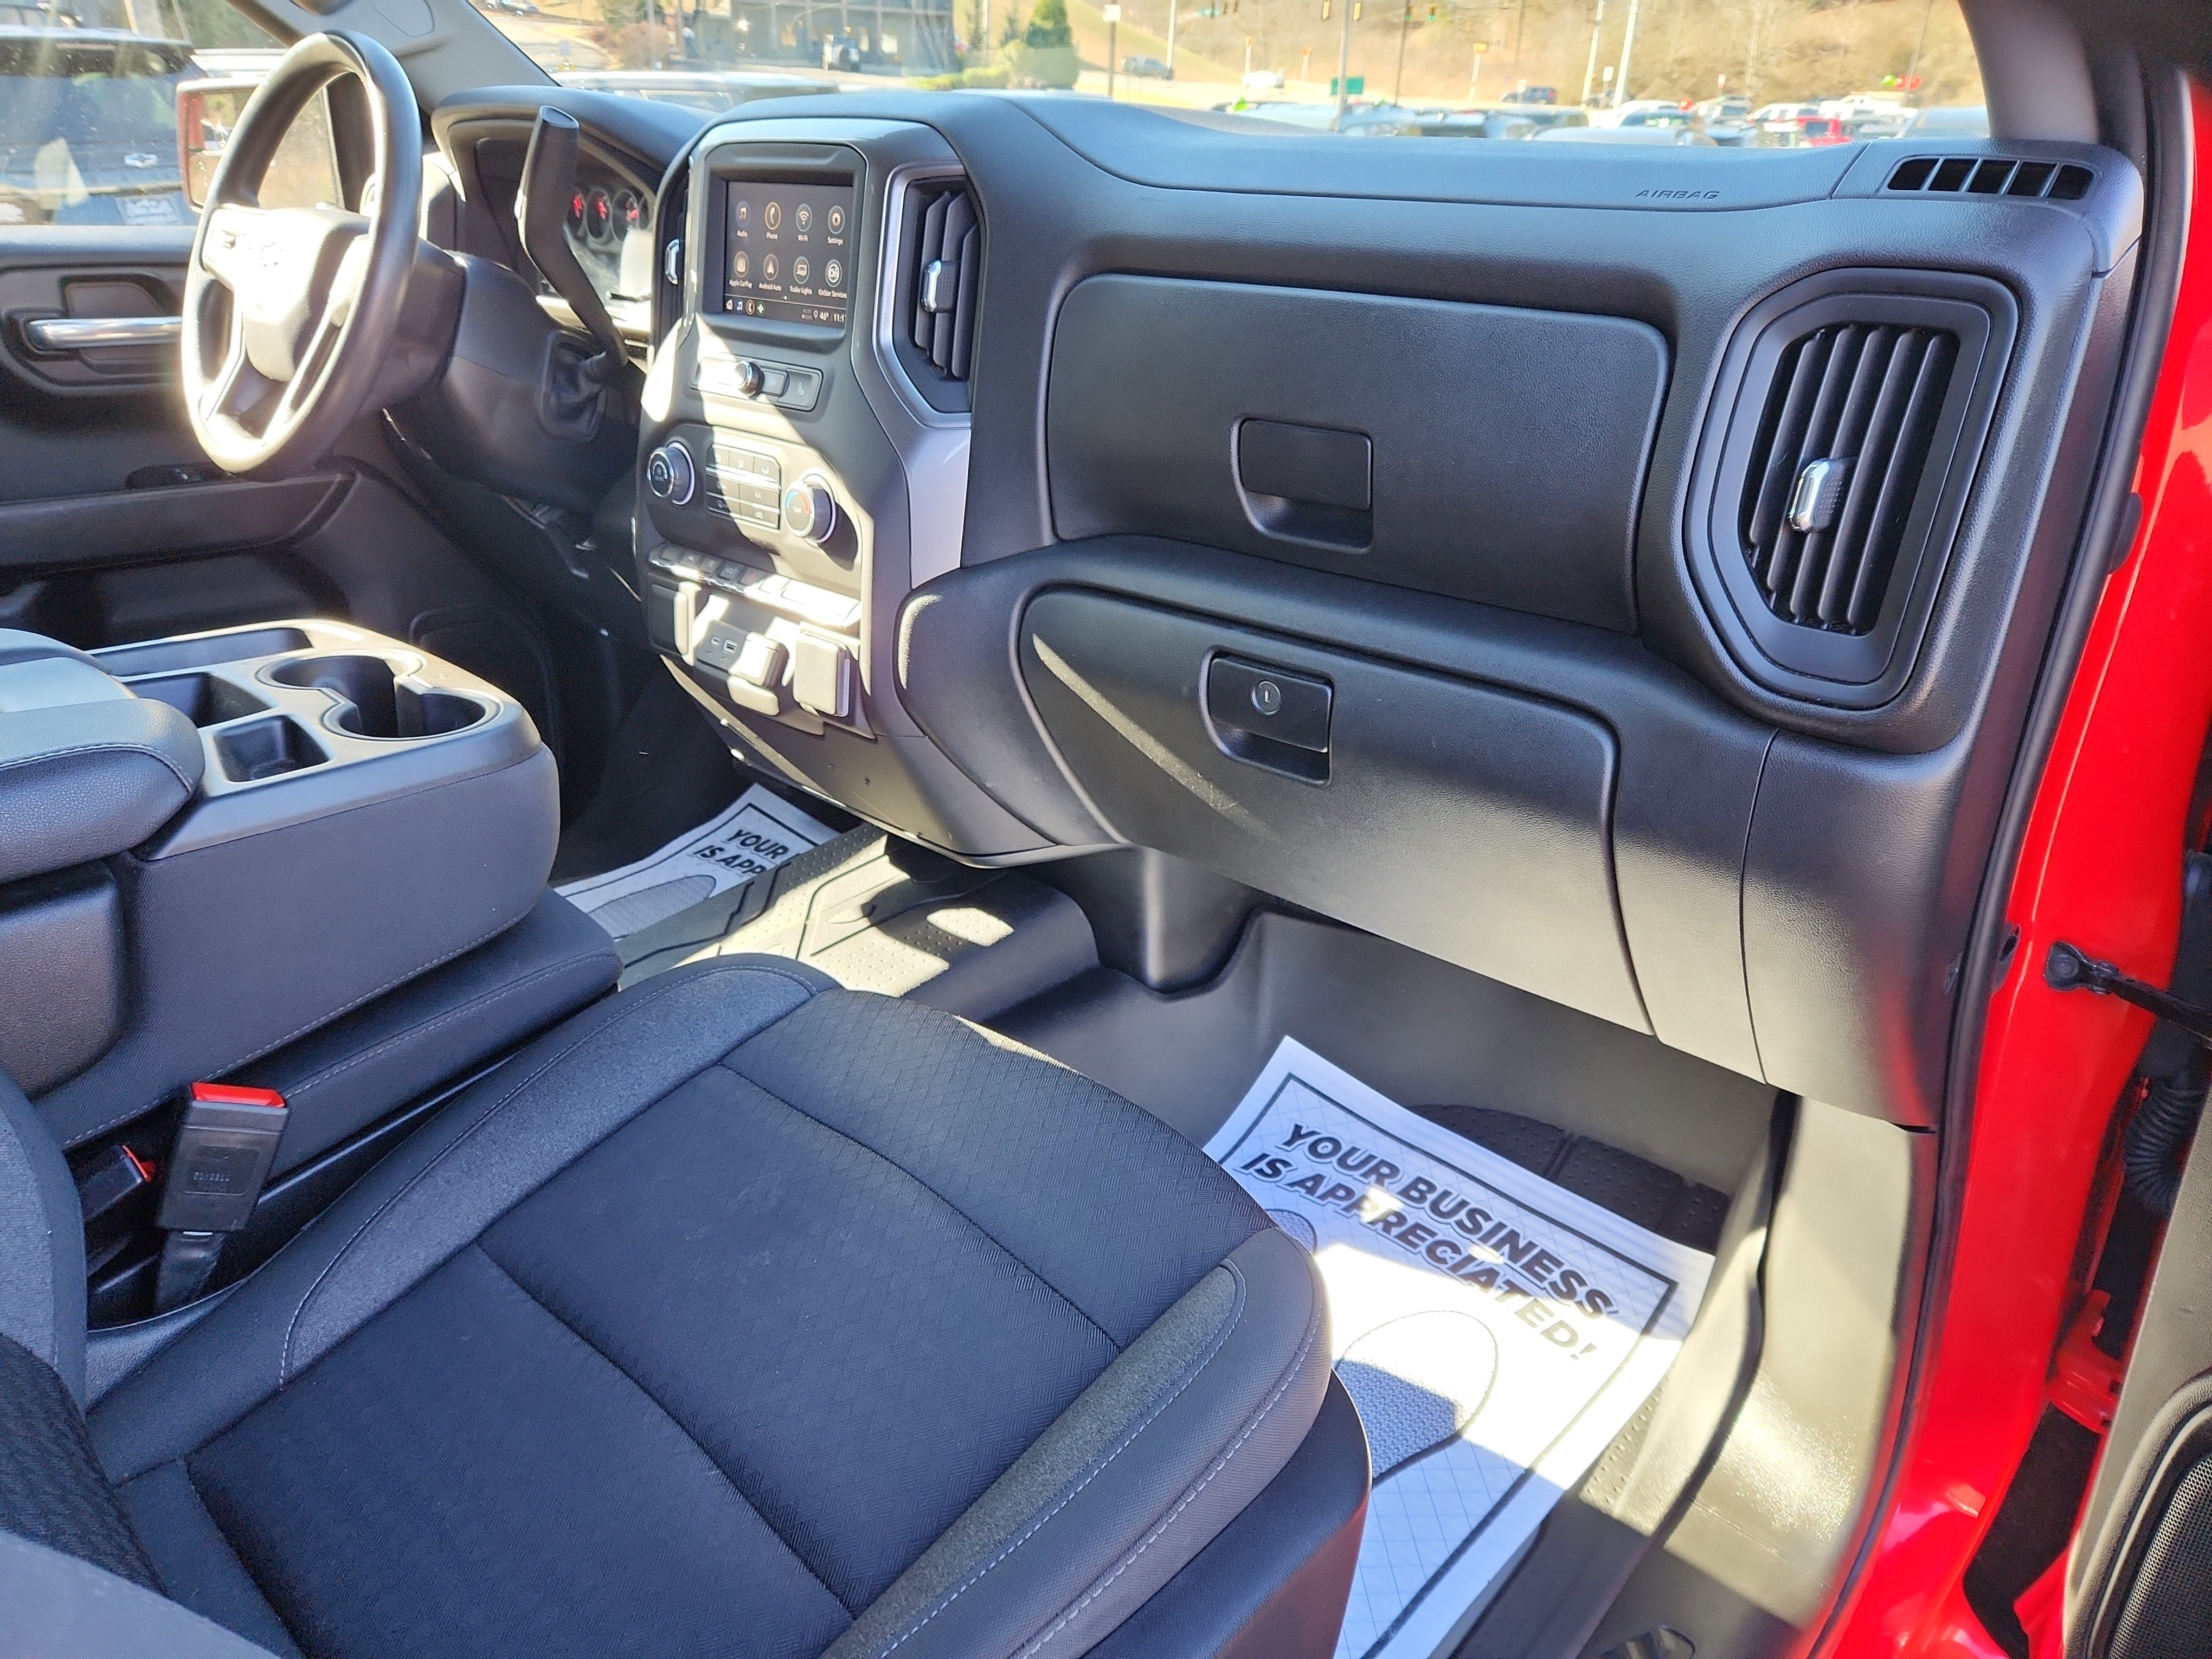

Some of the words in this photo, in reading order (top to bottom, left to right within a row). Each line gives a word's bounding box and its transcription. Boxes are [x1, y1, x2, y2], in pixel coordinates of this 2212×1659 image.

[1636, 190, 1720, 199] AIRBAG
[827, 236, 844, 246] Settings
[789, 285, 801, 293] Trailer
[801, 287, 813, 295] Lights
[831, 290, 847, 299] Services
[725, 829, 789, 860] YOUR
[693, 845, 725, 858] IS
[1281, 1124, 1401, 1188] YOUR
[1401, 1175, 1615, 1319] BUSINESS
[1239, 1152, 1294, 1179] IS
[1284, 1173, 1598, 1360] APPRECIATED!
